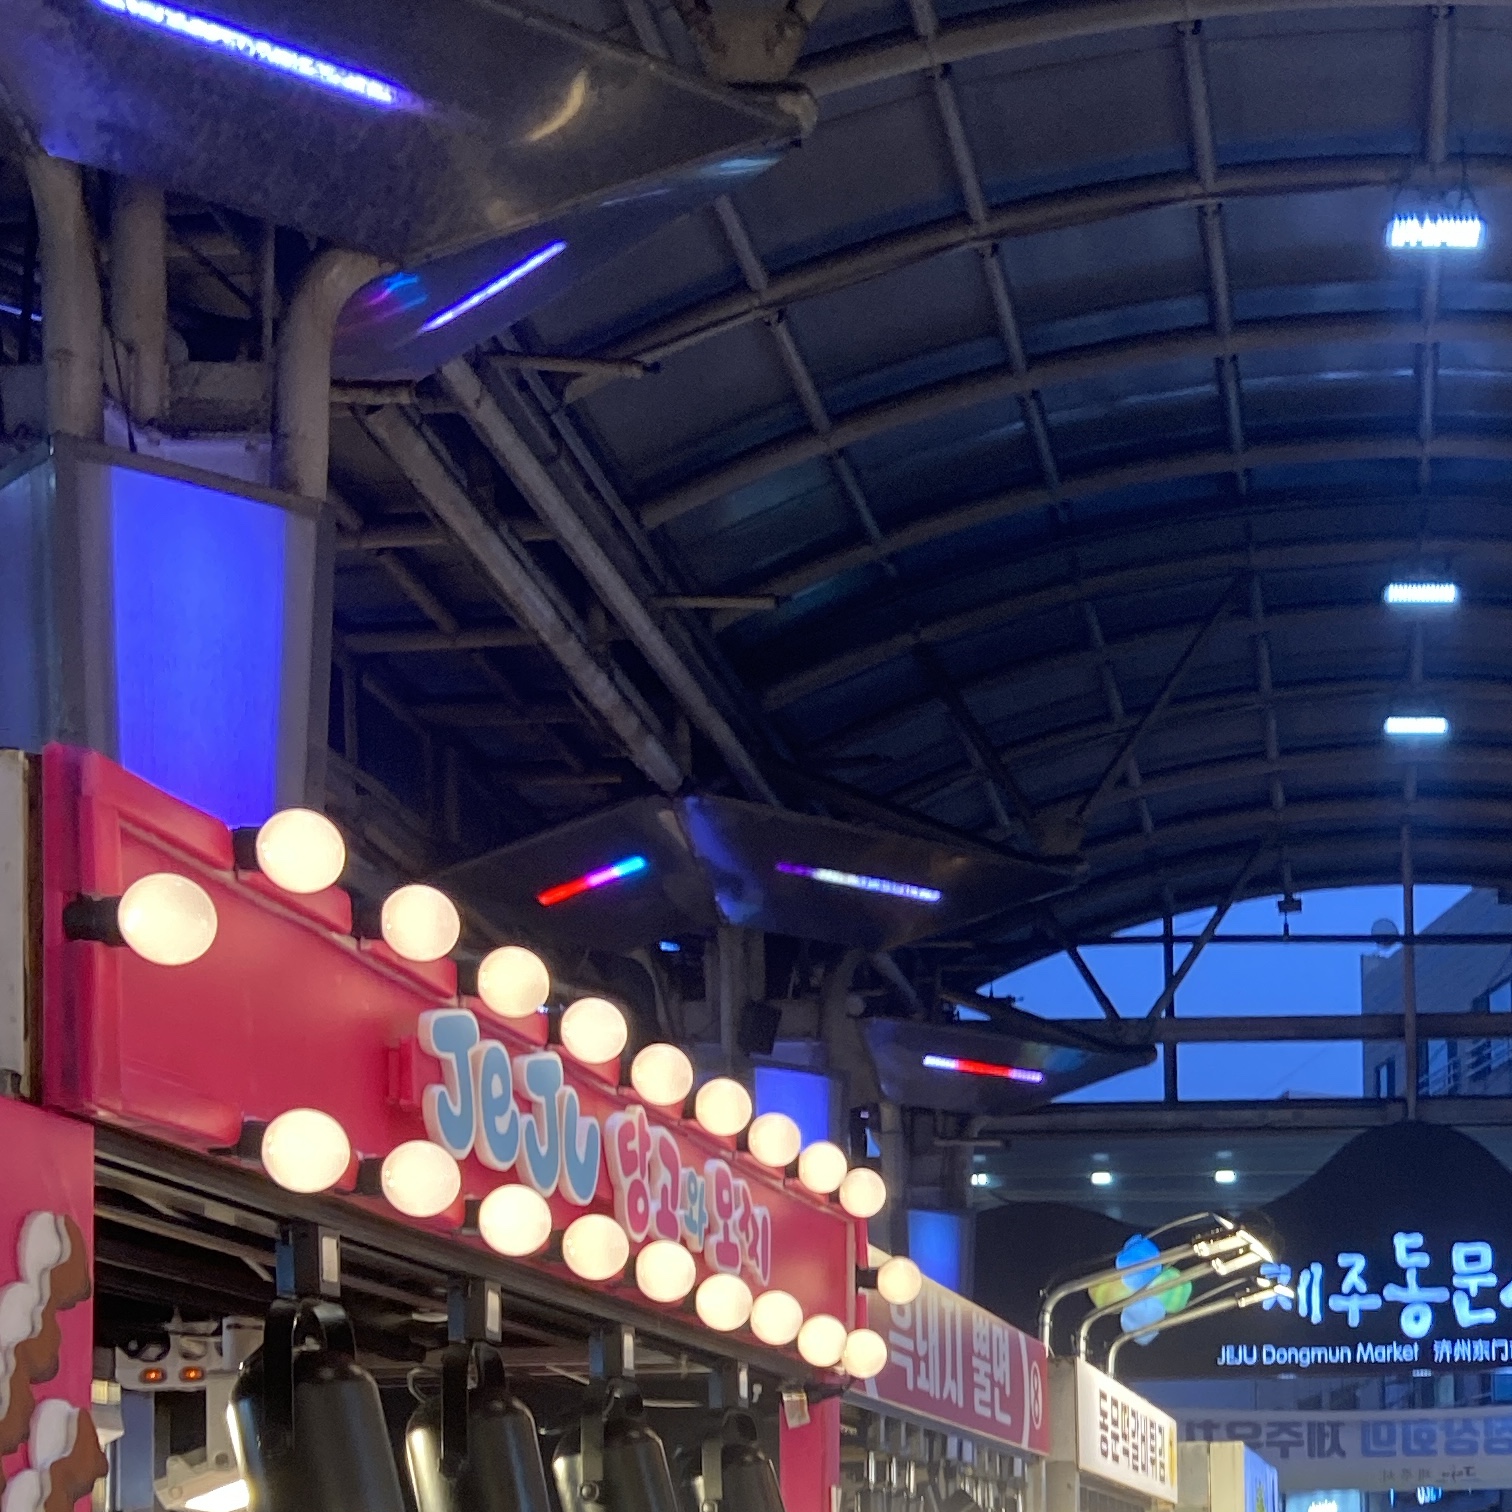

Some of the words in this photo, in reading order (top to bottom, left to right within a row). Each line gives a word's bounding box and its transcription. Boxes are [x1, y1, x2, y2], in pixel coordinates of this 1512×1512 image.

[888, 1288, 964, 1408] 흑돼지
[1217, 1344, 1257, 1366] JEJU
[1262, 1343, 1350, 1367] Dongmun
[1356, 1341, 1419, 1364] Market
